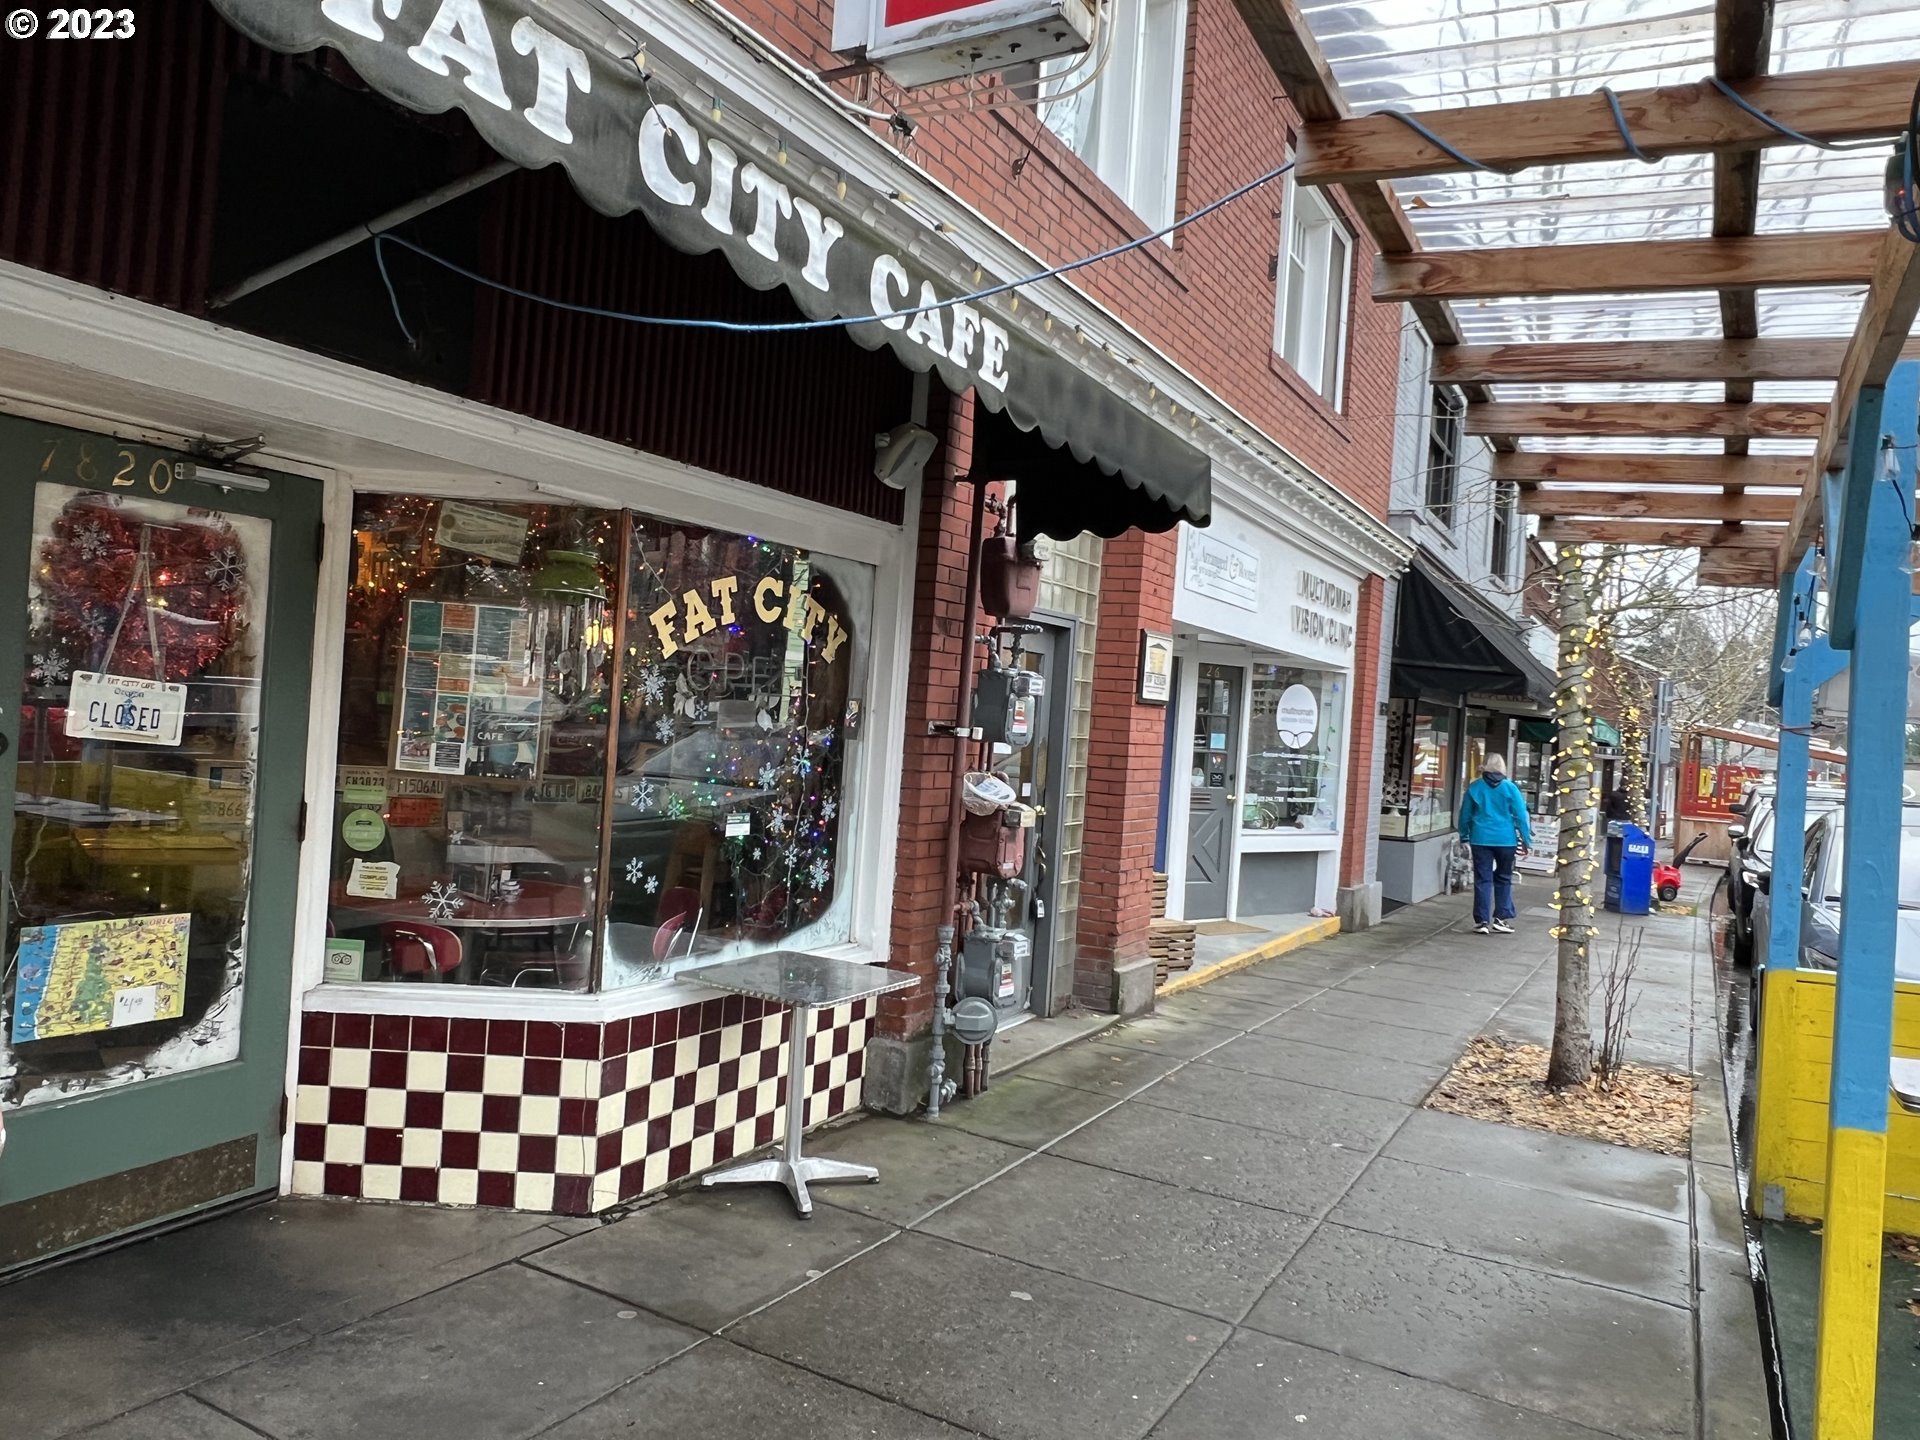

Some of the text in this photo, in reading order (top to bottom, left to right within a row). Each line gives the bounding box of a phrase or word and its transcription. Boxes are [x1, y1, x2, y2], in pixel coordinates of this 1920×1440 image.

[638, 103, 843, 293] CITY
[870, 254, 1011, 393] CAFE
[41, 440, 173, 495] 7820
[649, 575, 848, 664] FAT CITY
[1290, 605, 1325, 639] VISION
[88, 701, 161, 729] CLOSED
[477, 731, 504, 741] CAFE
